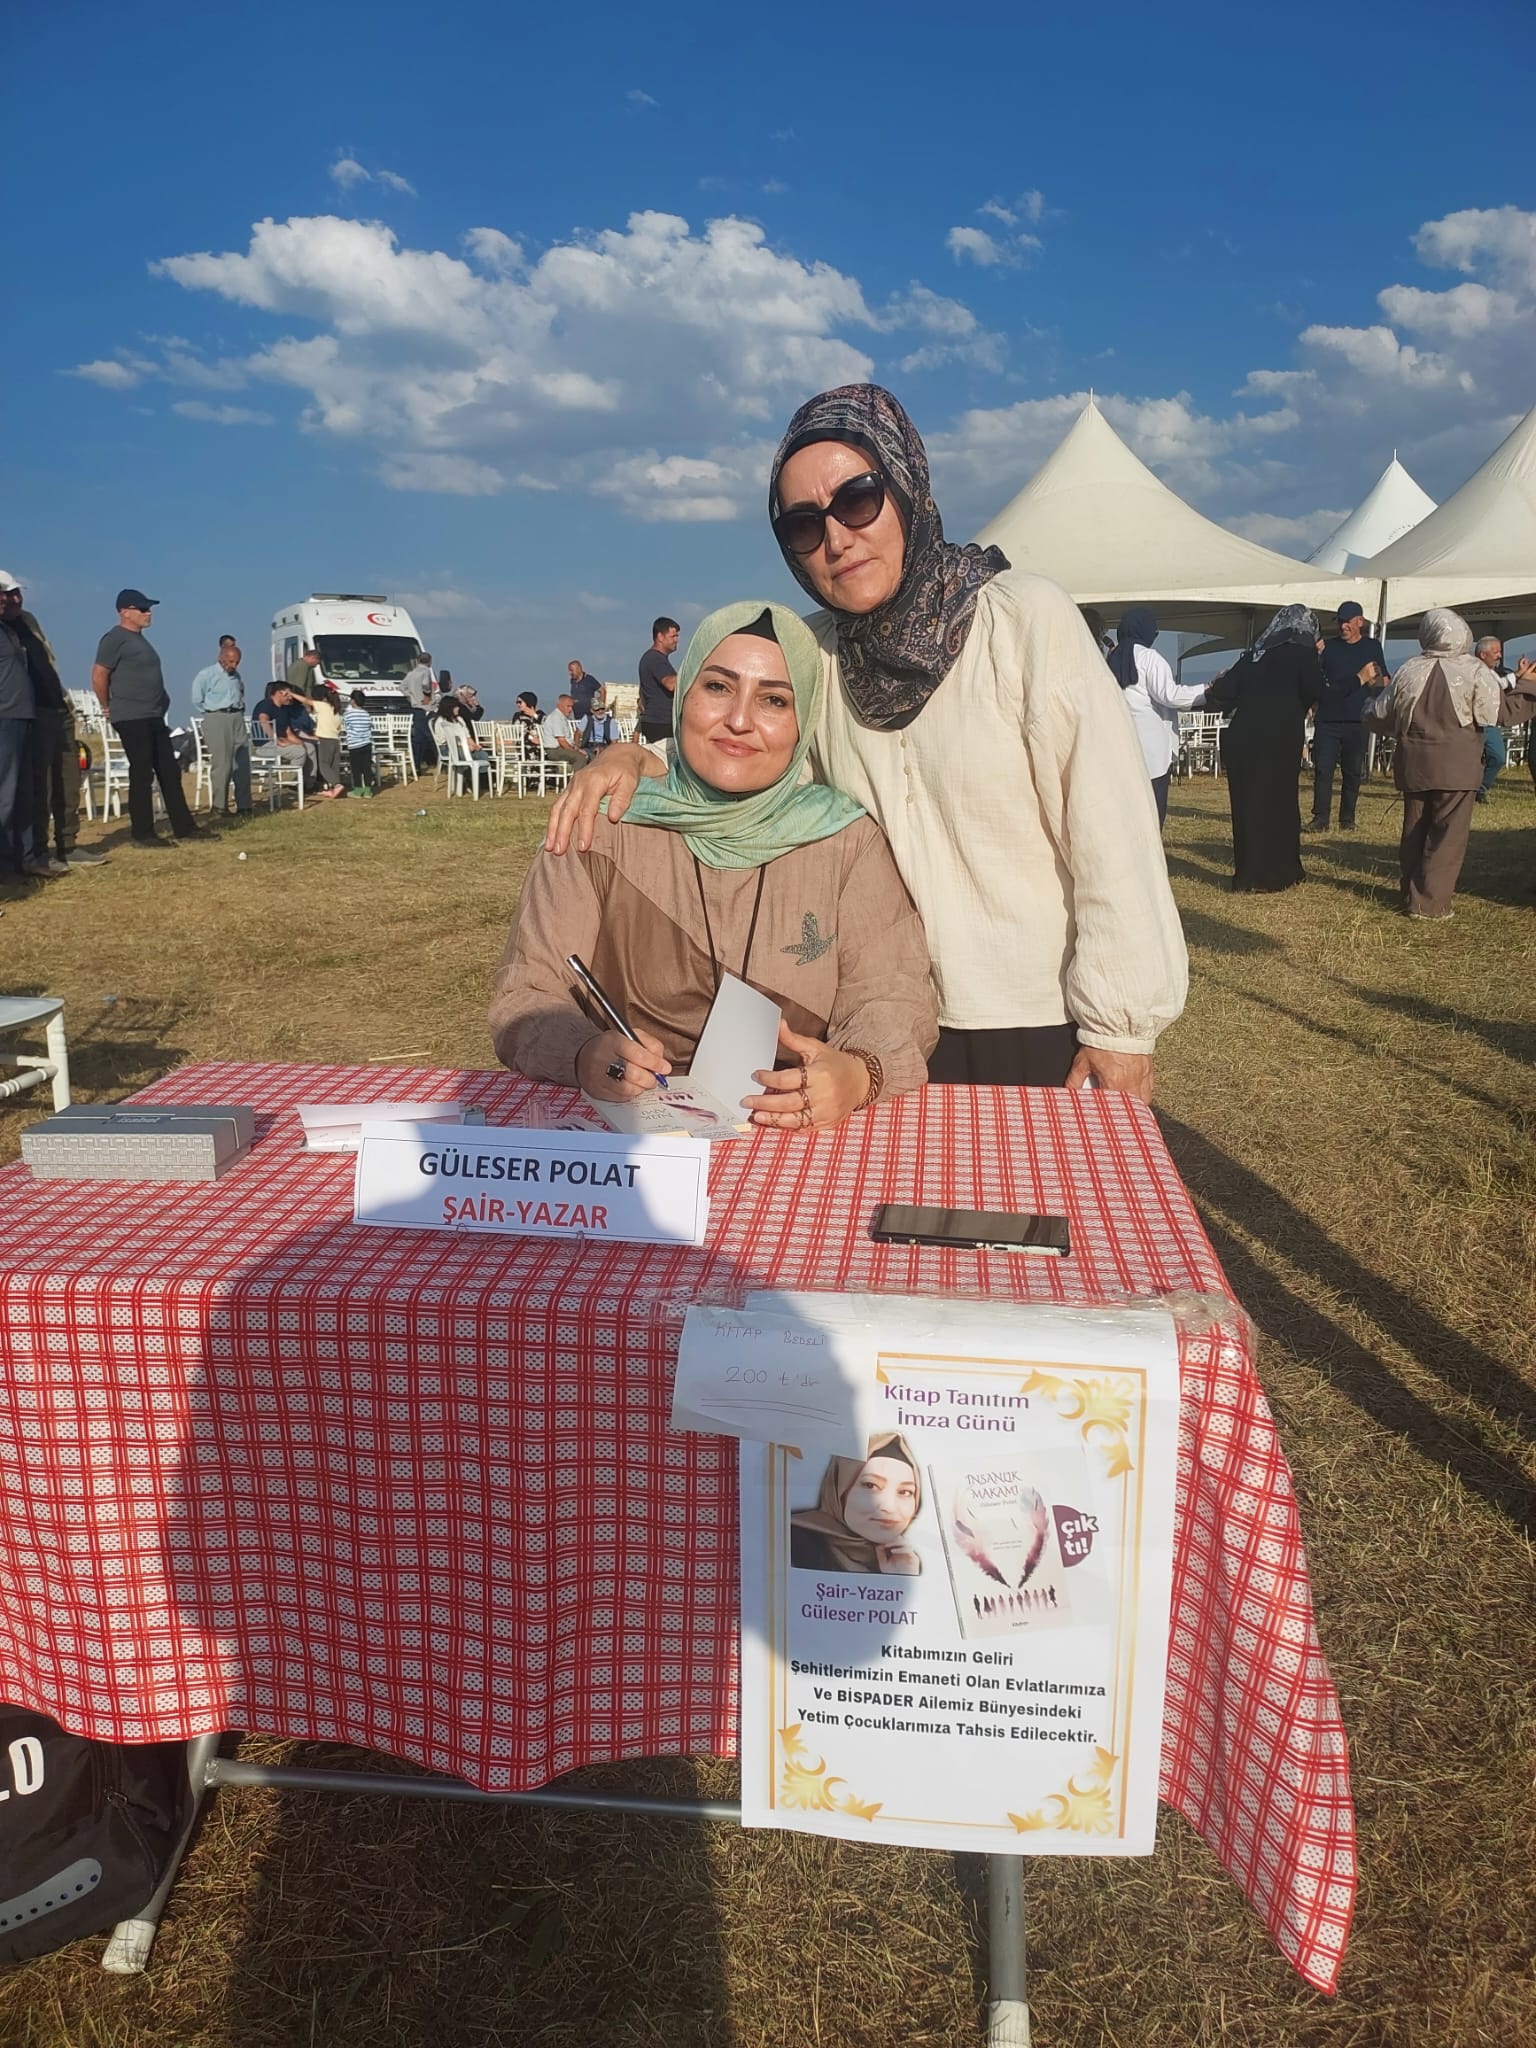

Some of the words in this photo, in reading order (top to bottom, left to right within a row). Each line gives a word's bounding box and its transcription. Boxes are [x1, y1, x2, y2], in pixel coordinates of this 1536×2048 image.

[418, 1148, 541, 1183] GÜLESER
[549, 1159, 641, 1188] POLAT
[442, 1192, 608, 1229] ŞAİR-YAZAR
[714, 1321, 762, 1338] KİTAP
[725, 1366, 768, 1384] 200
[884, 1384, 941, 1406] Kitap
[945, 1389, 1030, 1409] Tanıtım
[897, 1407, 950, 1428] İmza
[956, 1413, 1016, 1432] Günü
[1060, 1514, 1099, 1538] çık
[1063, 1537, 1090, 1556] tı!
[816, 1582, 904, 1601] Şair-Yazar
[801, 1604, 865, 1623] Güleser
[868, 1609, 918, 1625] POLAT
[881, 1644, 967, 1663] Kitabımızın
[972, 1650, 1014, 1666] Geliri
[791, 1660, 893, 1682] Şehitlerimizin
[898, 1670, 961, 1687] Emaneti
[966, 1674, 1000, 1689] Olan
[1005, 1678, 1106, 1697] Evlatlarımıza
[813, 1687, 833, 1700] Ve
[837, 1687, 914, 1708] BİSPADER
[918, 1696, 974, 1712] Ailemiz
[979, 1700, 1082, 1719] Bünyesindeki
[798, 1708, 839, 1725] Yetim
[844, 1714, 951, 1735] Çocuklarımıza
[956, 1722, 1006, 1738] Tahsis
[1010, 1726, 1097, 1743] Edilecektir.
